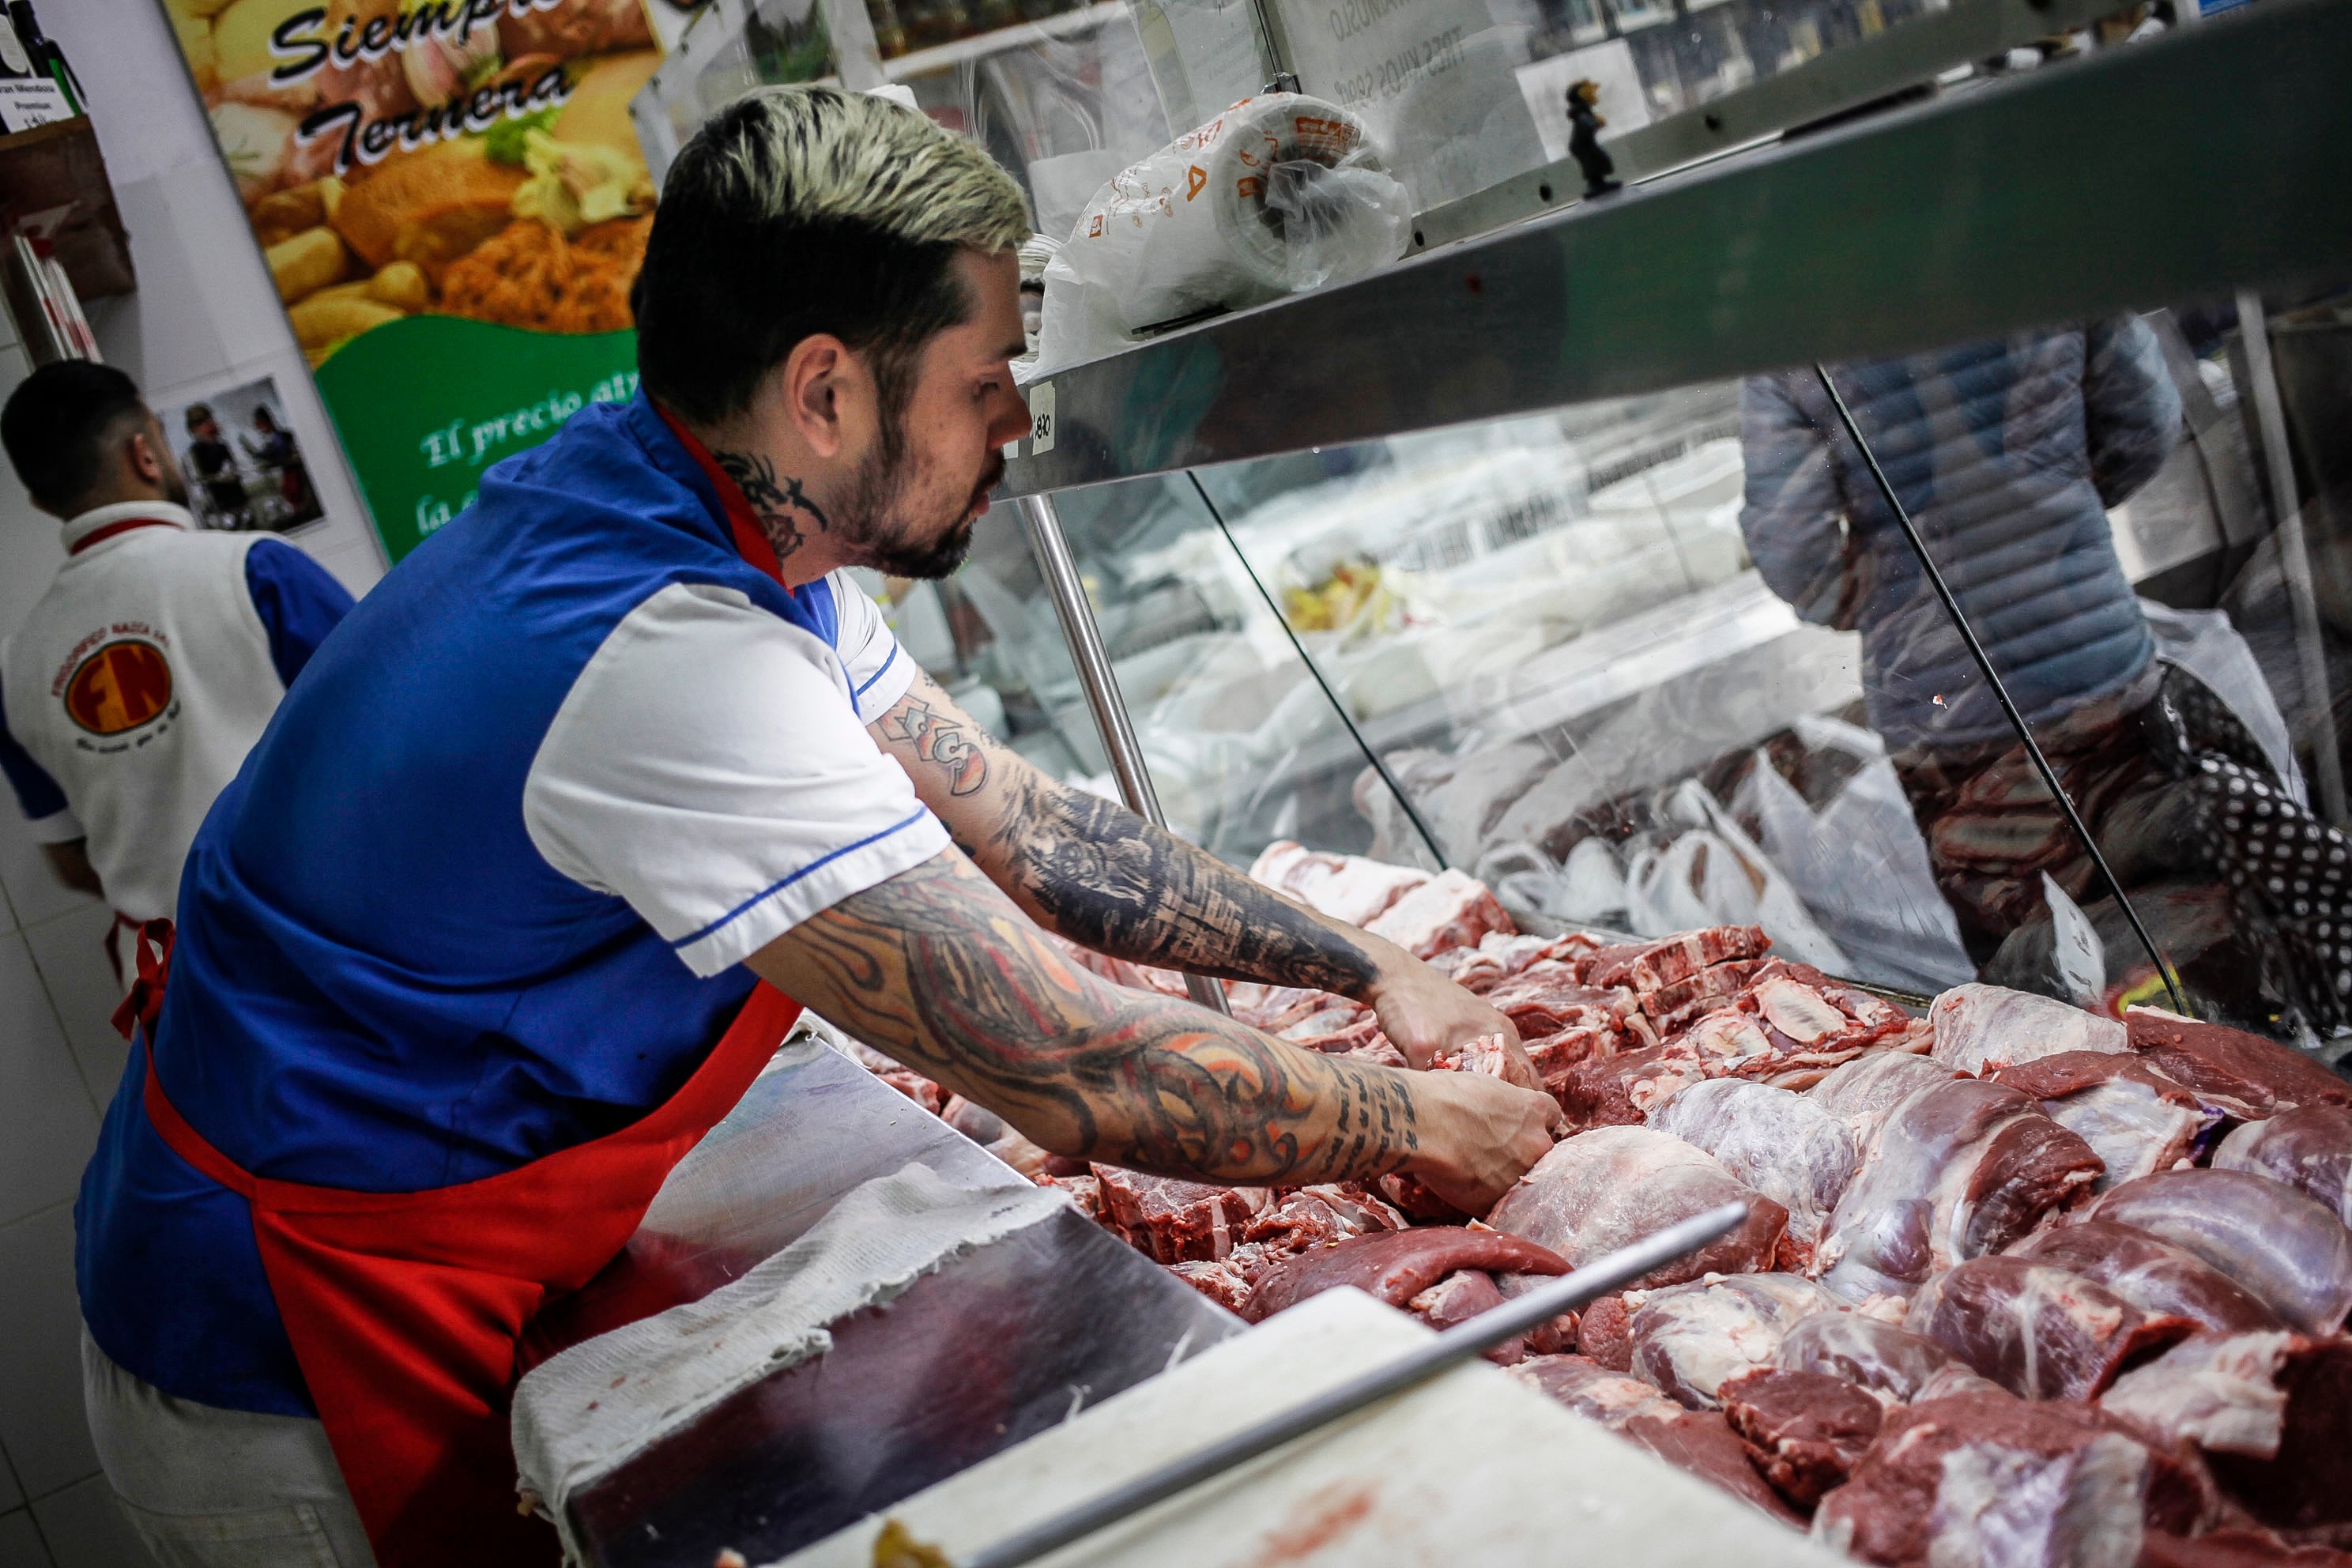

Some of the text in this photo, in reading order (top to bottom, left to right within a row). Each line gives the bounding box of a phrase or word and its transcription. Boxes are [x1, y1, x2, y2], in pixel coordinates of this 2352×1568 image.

[269, 0, 563, 89] Siemp
[295, 65, 579, 175] Ternera
[420, 410, 466, 468] El
[466, 389, 583, 466] precio
